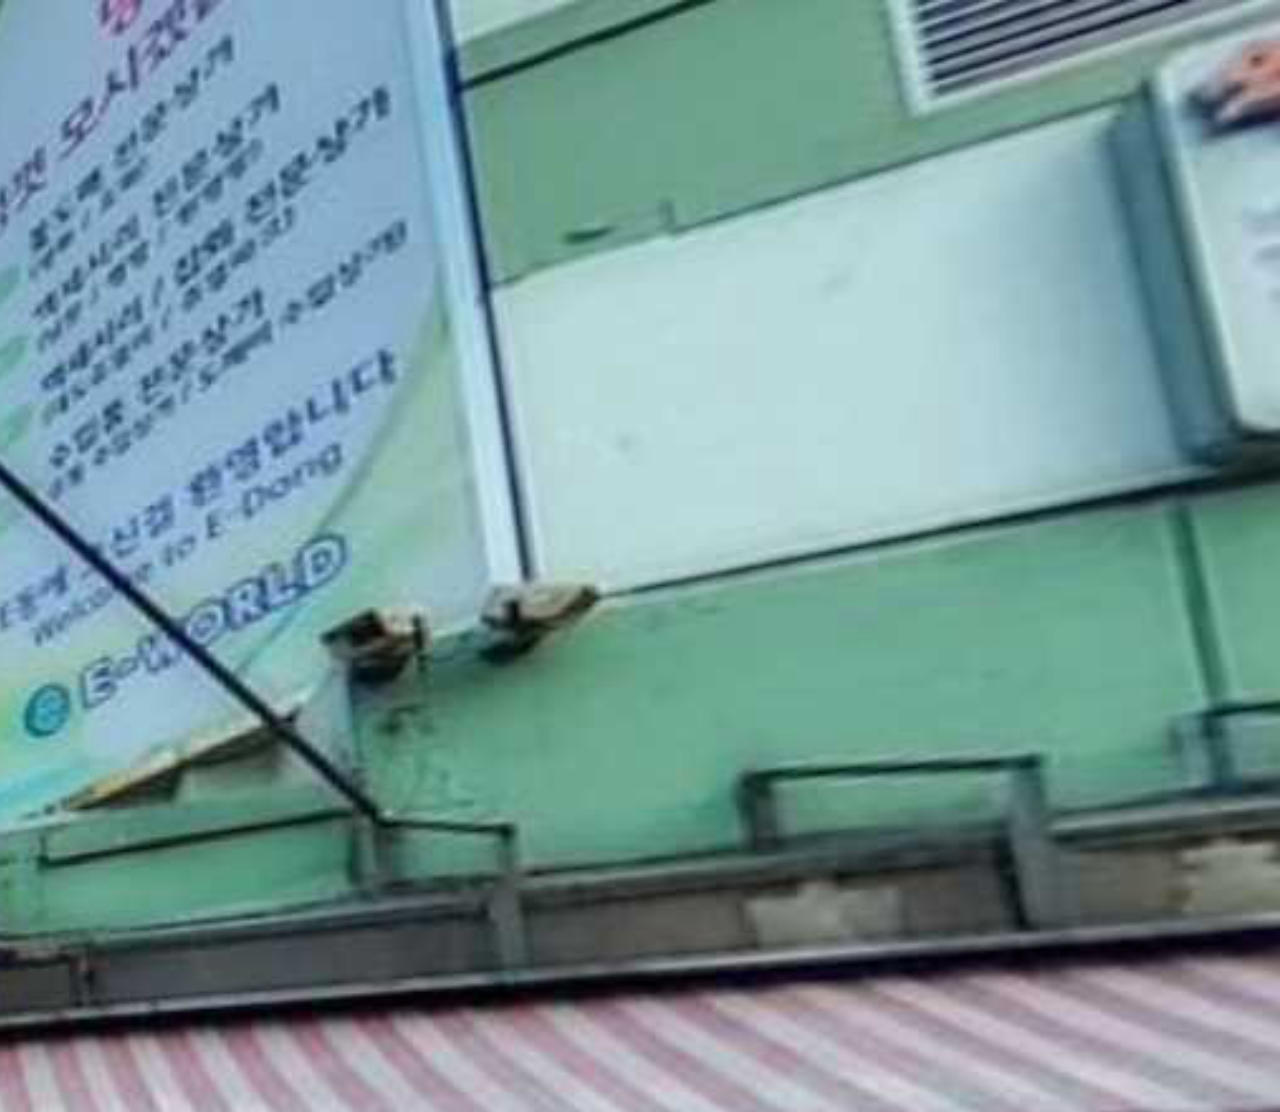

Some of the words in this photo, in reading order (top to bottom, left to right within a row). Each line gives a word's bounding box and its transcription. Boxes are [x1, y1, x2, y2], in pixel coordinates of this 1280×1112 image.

[60, 0, 225, 162] 모시겠
[187, 347, 397, 508] 환영합니다
[32, 561, 153, 647] Welcoe
